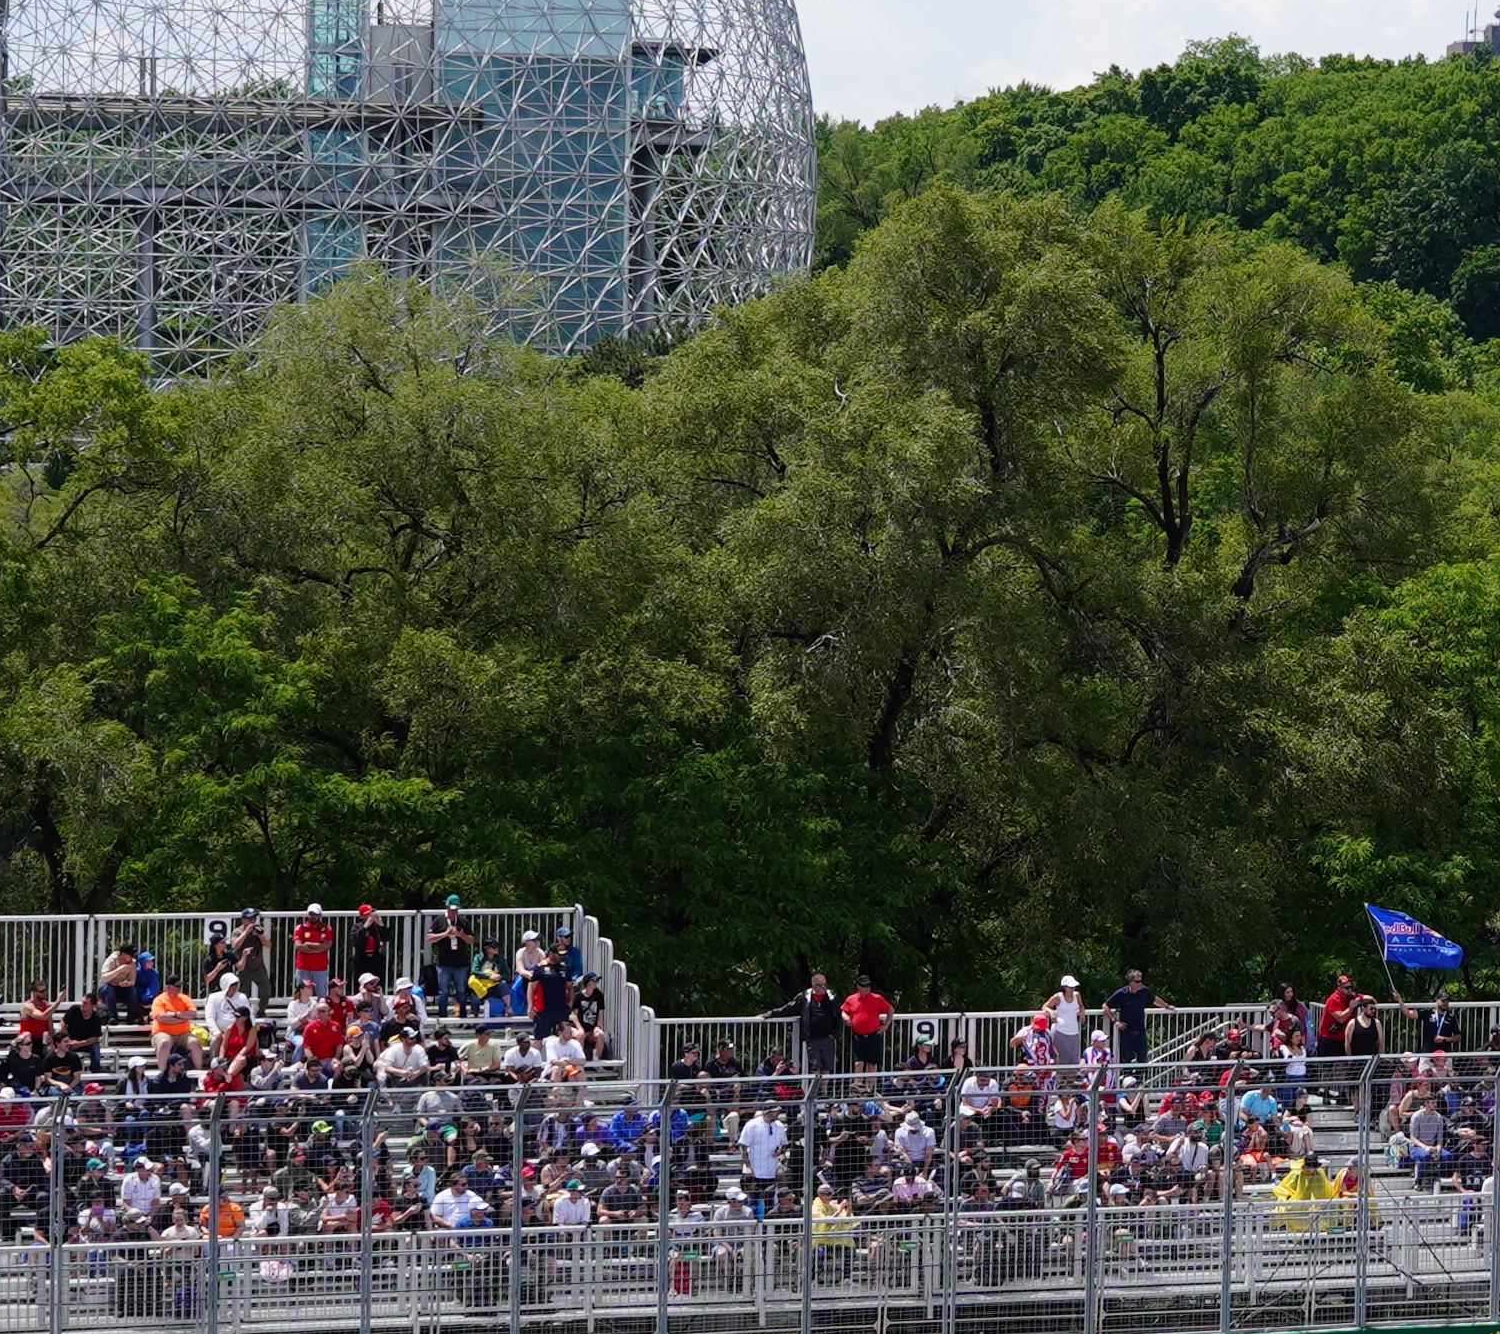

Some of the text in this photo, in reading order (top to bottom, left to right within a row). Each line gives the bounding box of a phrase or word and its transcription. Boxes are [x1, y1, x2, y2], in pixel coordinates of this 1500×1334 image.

[209, 920, 228, 939] 9
[1400, 922, 1420, 935] Bull
[1390, 936, 1454, 947] ACING
[917, 1021, 935, 1040] 9
